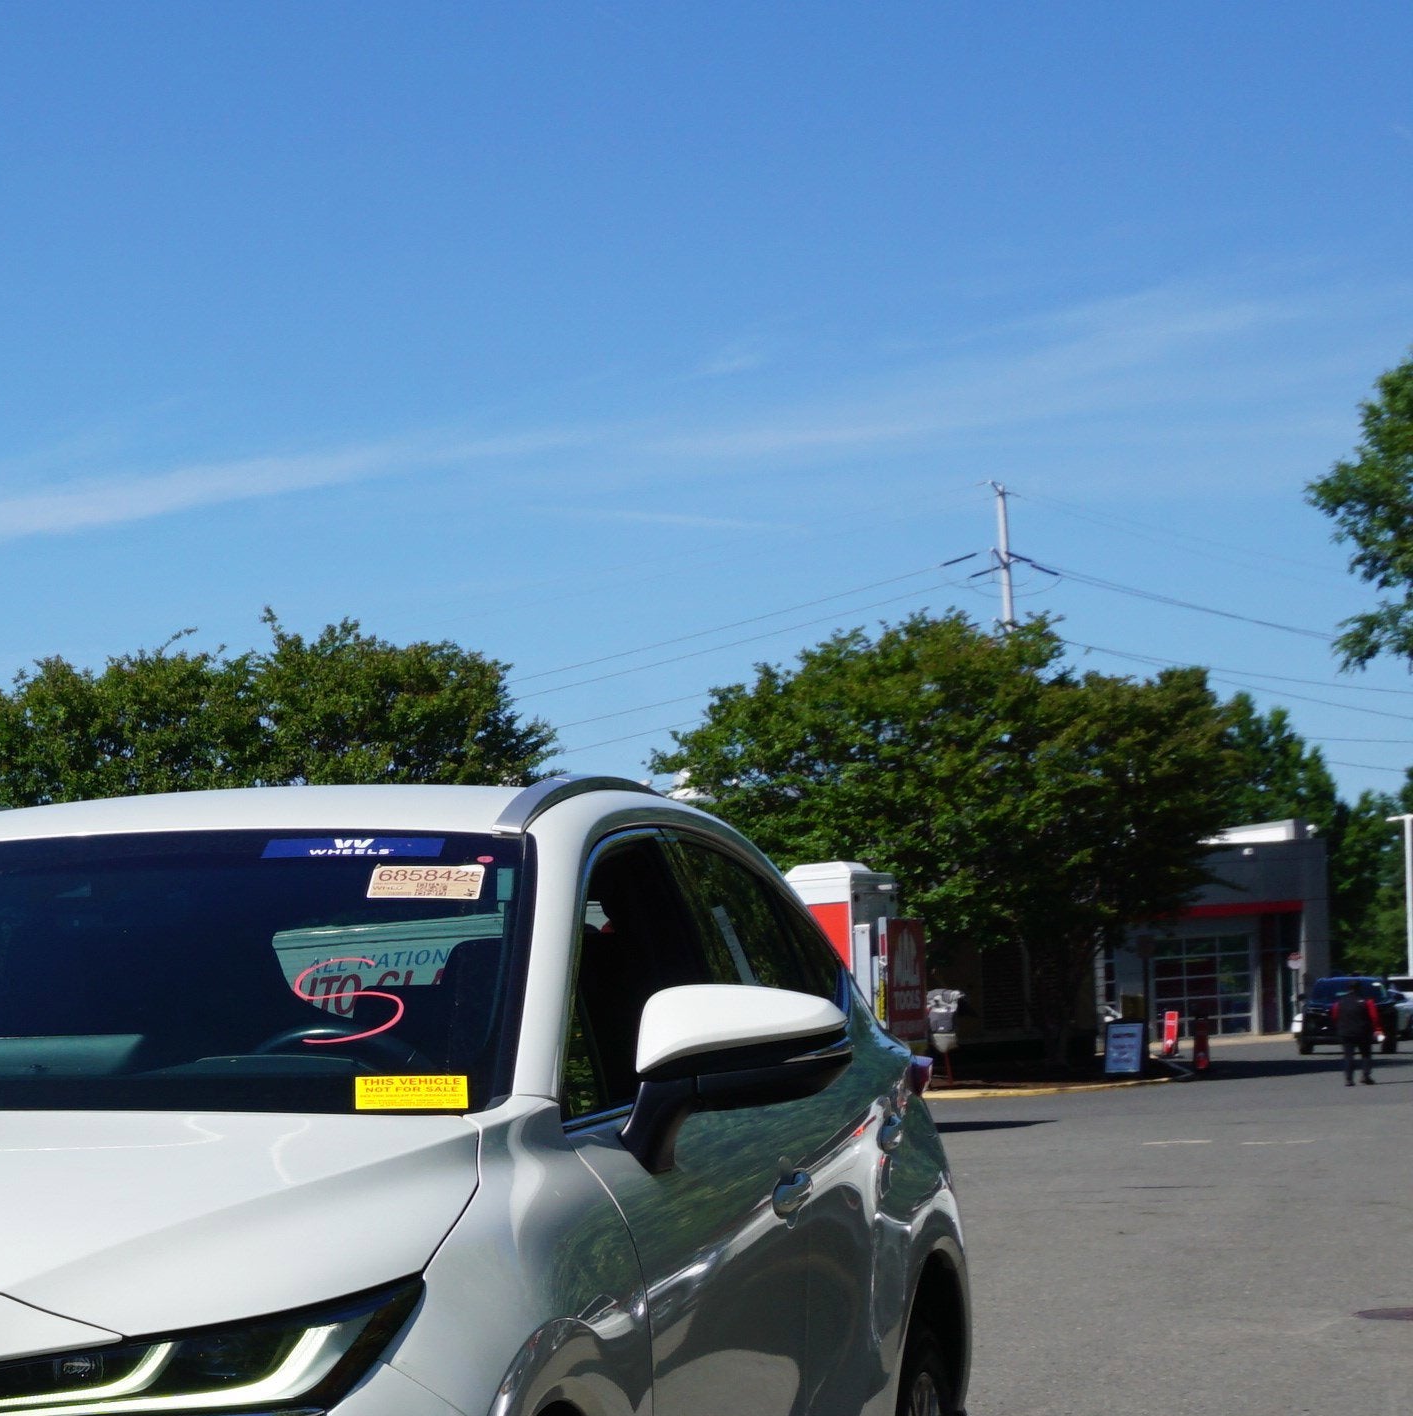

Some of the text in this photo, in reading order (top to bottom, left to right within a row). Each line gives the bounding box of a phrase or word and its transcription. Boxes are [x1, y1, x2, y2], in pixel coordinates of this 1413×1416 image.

[379, 869, 481, 882] 6858425
[310, 948, 450, 973] ALL NATION
[362, 1078, 461, 1086] THIS VEHICLE
